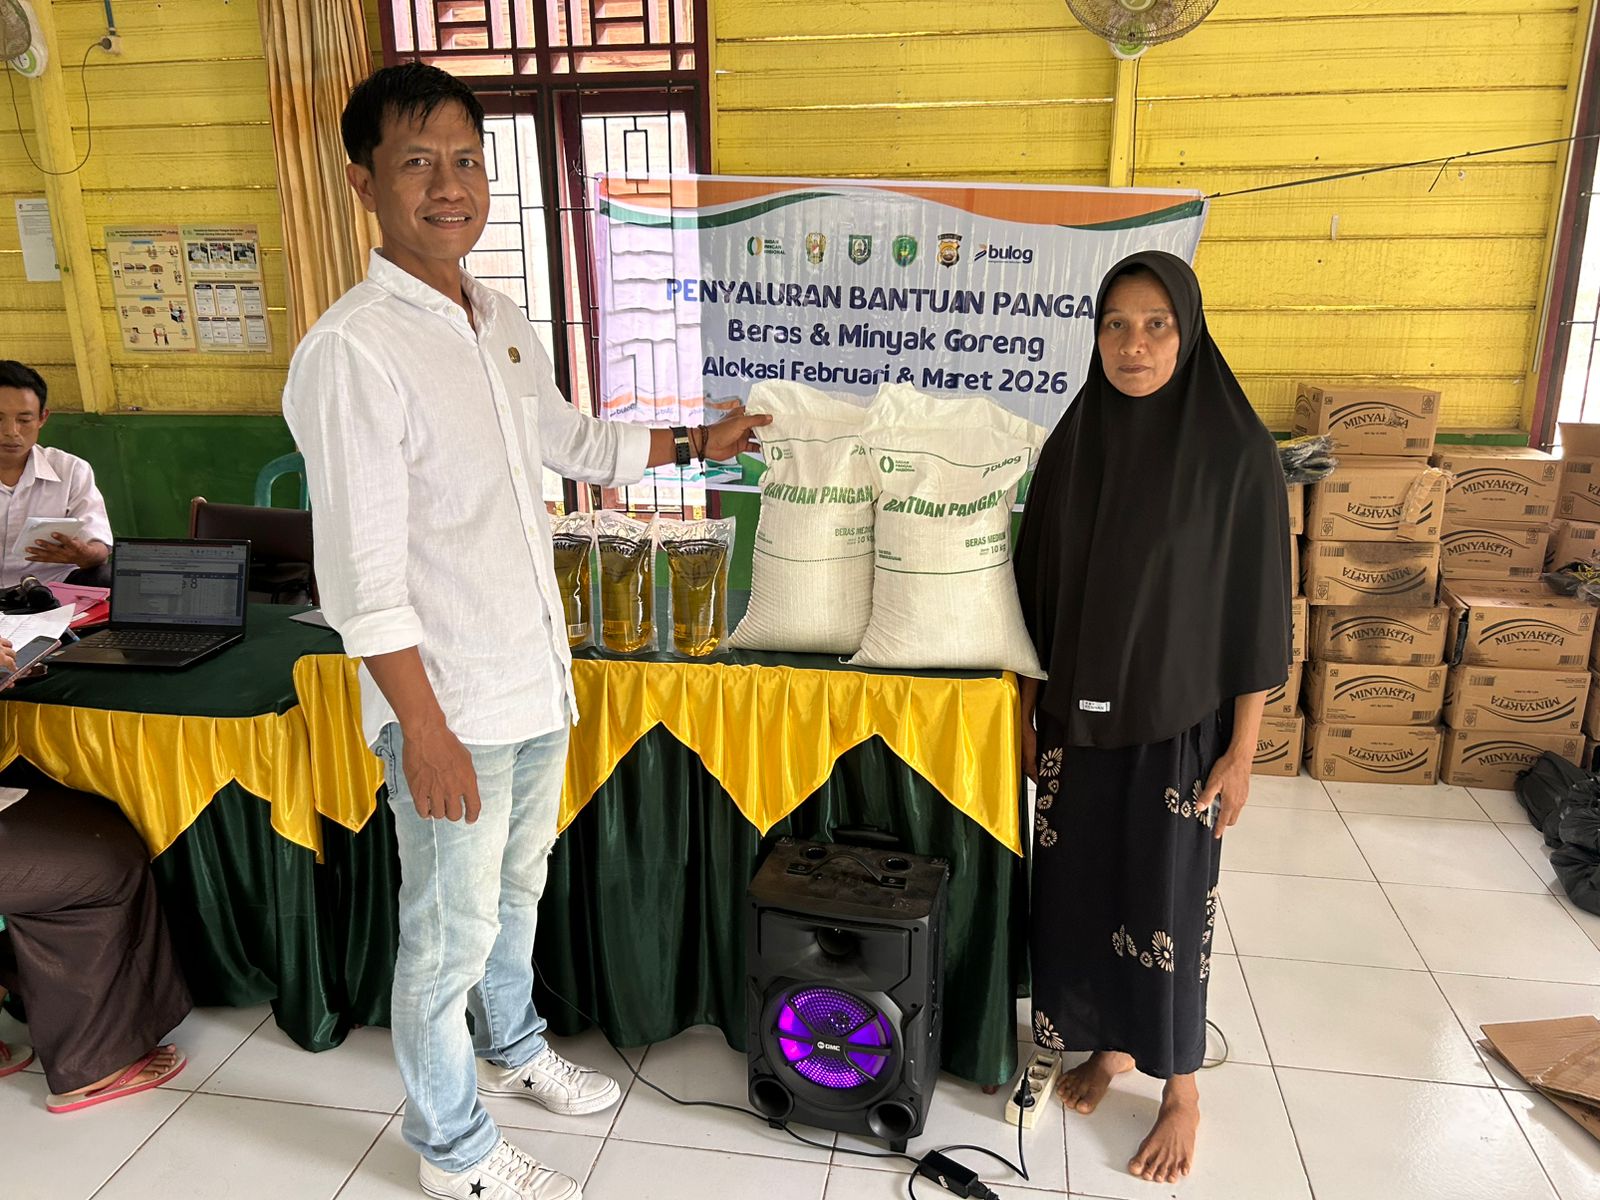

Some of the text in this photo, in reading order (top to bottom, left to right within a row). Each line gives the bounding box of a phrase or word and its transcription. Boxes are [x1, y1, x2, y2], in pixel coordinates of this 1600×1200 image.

[988, 244, 1033, 264] bulog
[666, 278, 1095, 320] PENYALURAN BANTUAN PANGA
[728, 319, 1045, 362] Beras & Minyak Goreng
[702, 356, 1068, 394] Alokasi Februari & Maret 2026
[763, 482, 873, 504] BANTUAN PANGAN
[1461, 479, 1529, 496] MINYAKITA
[1347, 502, 1402, 519] NYAKITA
[965, 536, 986, 548] BERAS
[991, 544, 999, 553] 10
[1446, 541, 1513, 558] MINYAKITA
[1342, 566, 1411, 584] MINYAKITA
[1345, 627, 1415, 644] MINYAKITA
[1495, 630, 1565, 646] MINYAKITA
[1349, 686, 1416, 703] MINYAKITA
[1490, 695, 1561, 712] MINYAKITA
[1348, 745, 1415, 763] MINYAKITA
